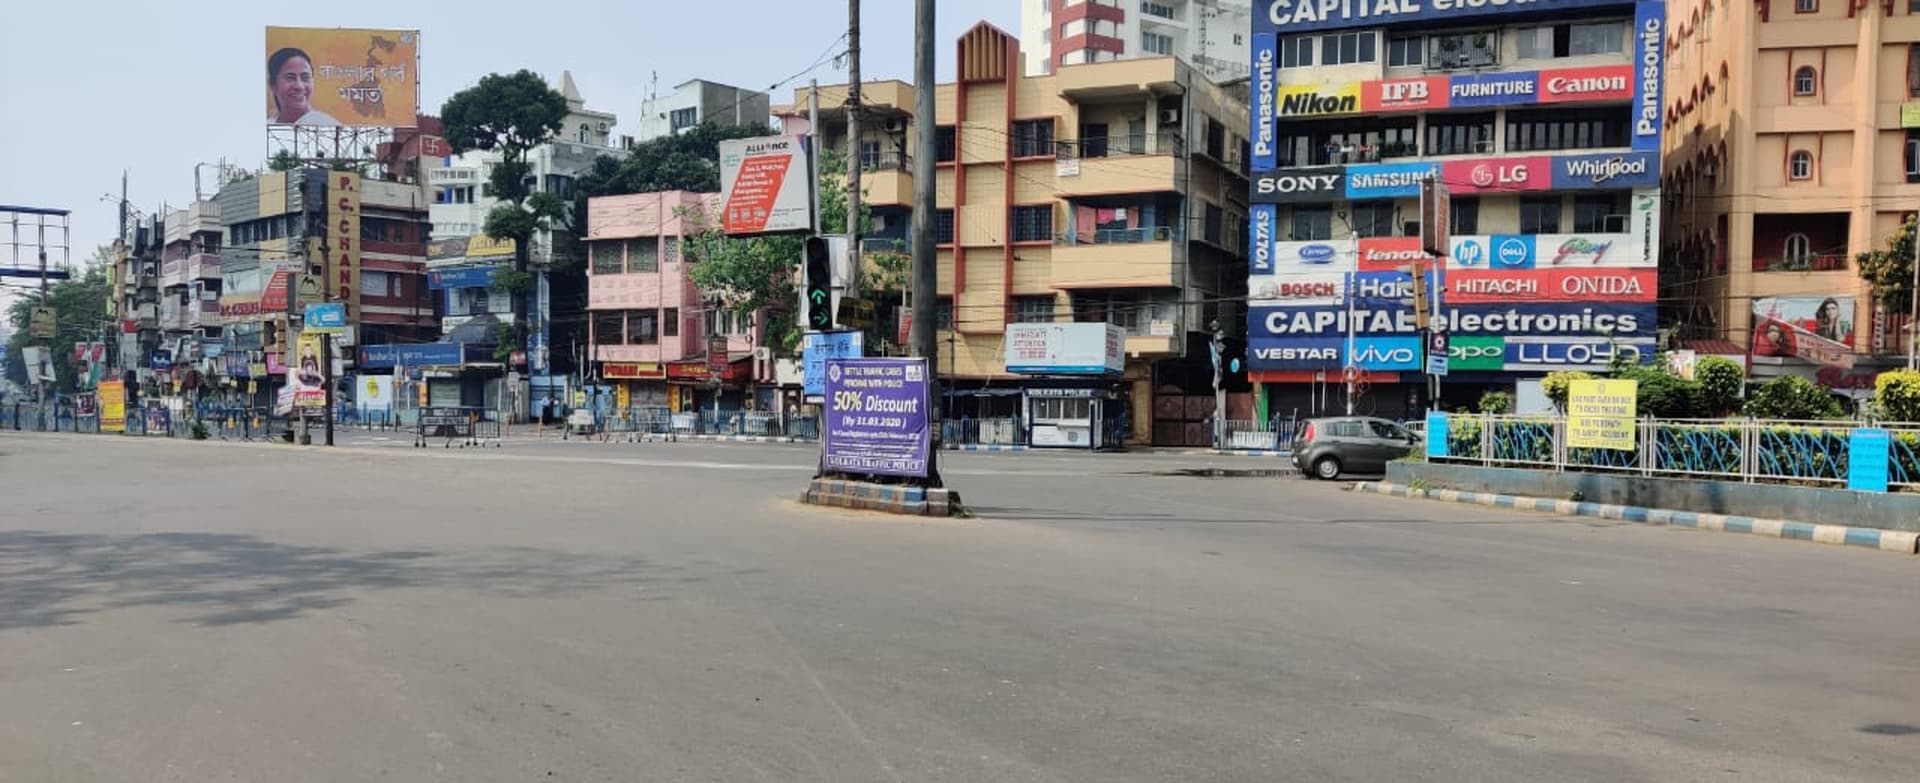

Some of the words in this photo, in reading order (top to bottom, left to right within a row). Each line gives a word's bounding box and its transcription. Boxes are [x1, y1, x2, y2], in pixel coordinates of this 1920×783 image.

[1547, 75, 1626, 94] Canon
[1637, 17, 1660, 135] Panasonic
[1381, 82, 1429, 101] IFB
[1451, 80, 1534, 97] FURNITURE
[1255, 48, 1273, 157] Panasonic
[1281, 93, 1356, 114] Nikon
[1499, 164, 1528, 183] LG
[1566, 158, 1645, 182] Whirlpool
[1257, 174, 1340, 193] SONY
[1255, 209, 1270, 270] VOLTAS
[1459, 239, 1479, 265] hp
[1502, 247, 1524, 257] DELL
[1280, 282, 1335, 298] BOSCH
[1359, 276, 1428, 298] Hai
[1455, 278, 1537, 294] HITACHI
[1561, 275, 1643, 295] ONIDA
[1265, 308, 1418, 334] CAPITAL
[1430, 308, 1638, 332] electronics
[1254, 347, 1338, 360] VESTAR
[1353, 344, 1413, 363] vivo
[1518, 343, 1641, 364] LLOYD
[833, 391, 863, 412] 50%
[865, 395, 918, 413] Discount
[1028, 388, 1063, 397] KOLKATA
[1064, 388, 1091, 397] POLICE
[892, 459, 920, 470] POLICE
